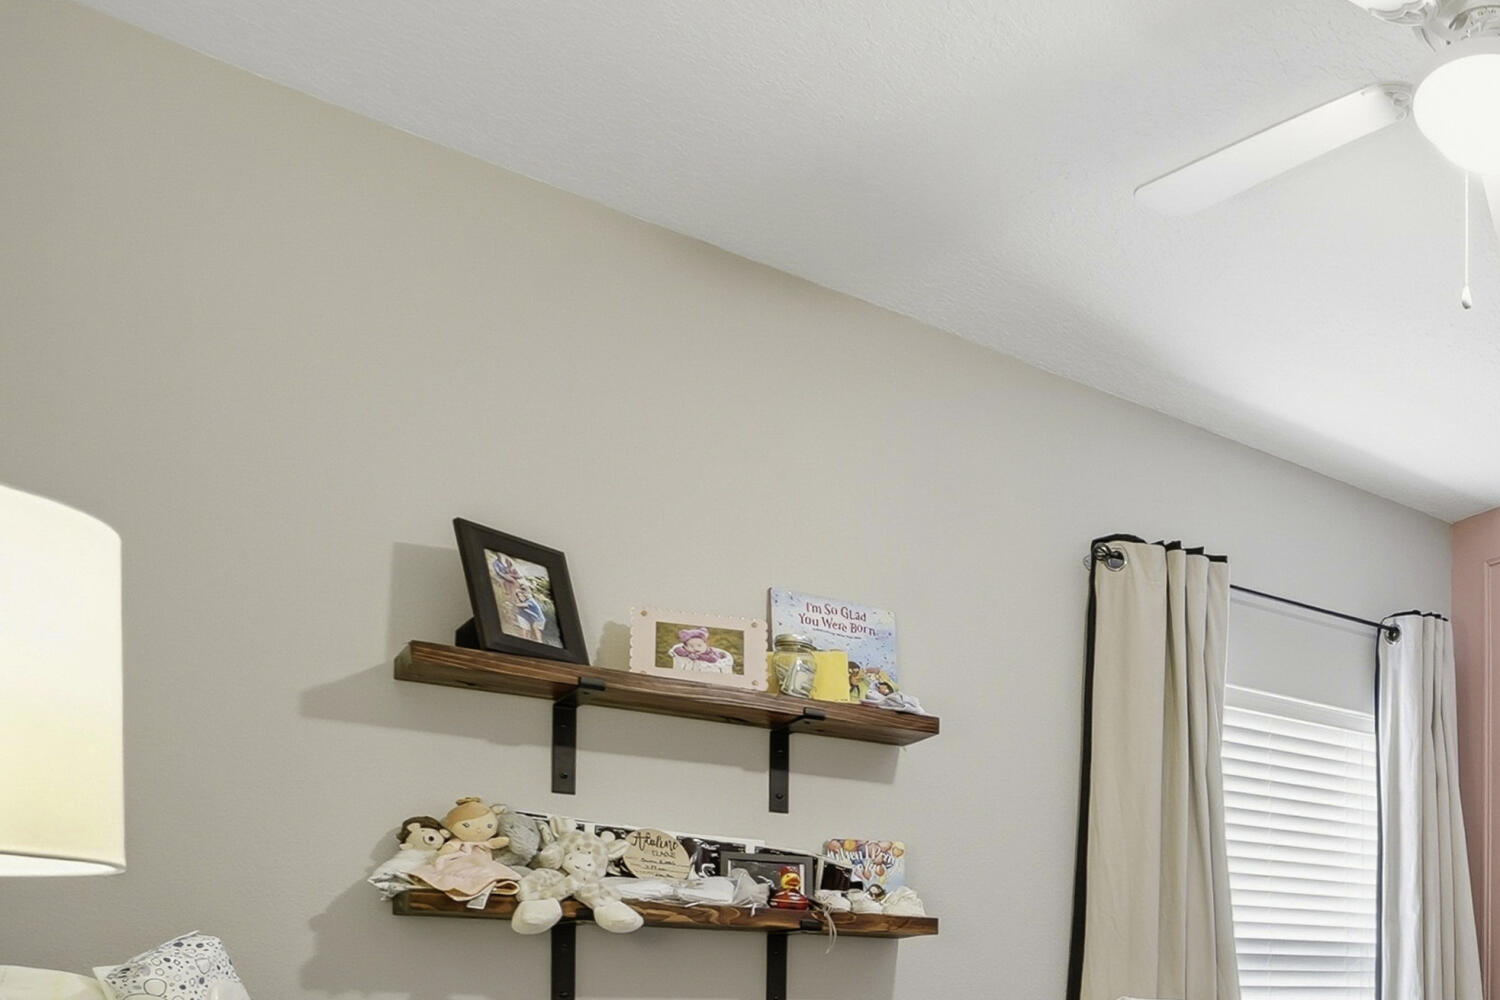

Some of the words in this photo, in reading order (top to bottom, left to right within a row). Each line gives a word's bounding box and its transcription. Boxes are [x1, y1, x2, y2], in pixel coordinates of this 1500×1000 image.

[806, 602, 822, 614] I'm
[824, 603, 838, 615] So
[799, 613, 819, 626] You
[821, 616, 847, 632] Were
[850, 622, 876, 636] Born
